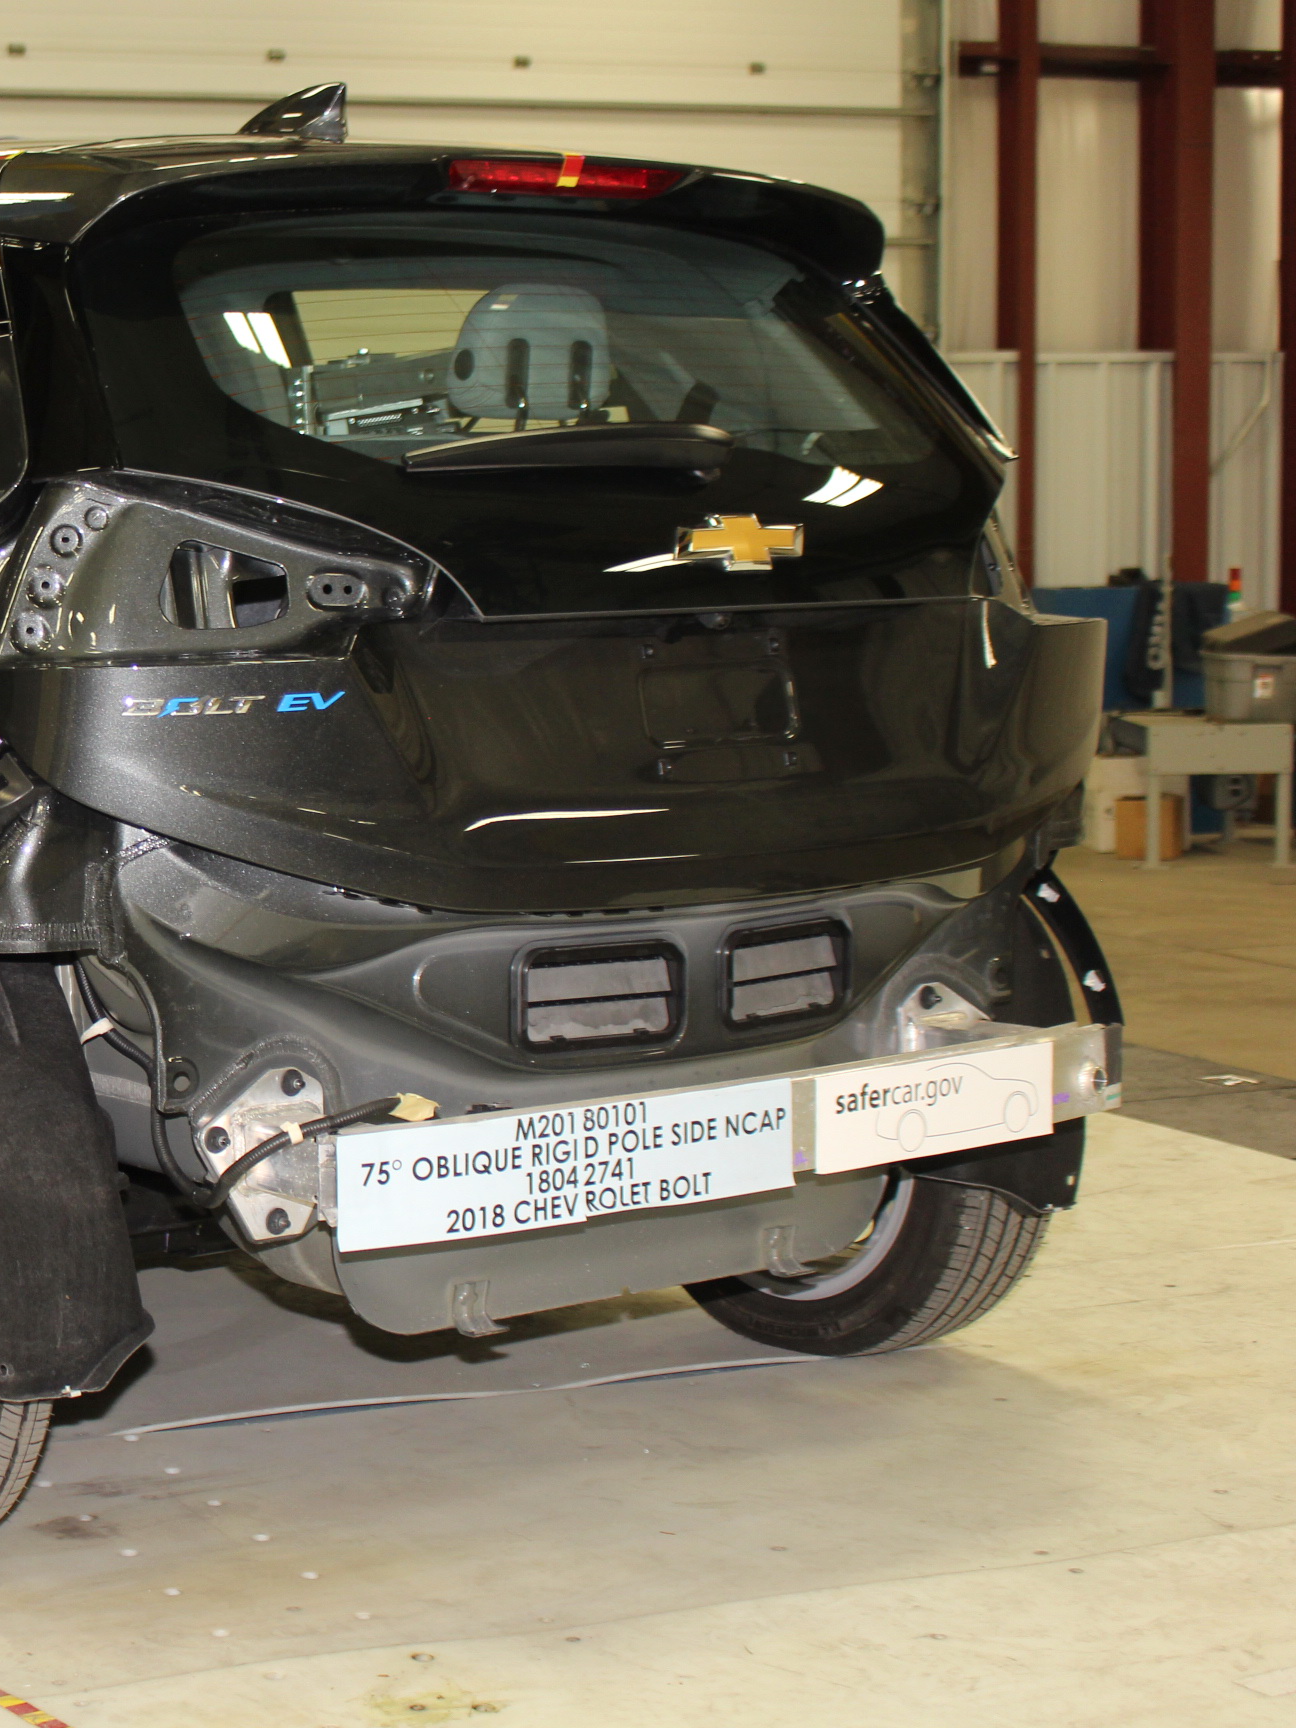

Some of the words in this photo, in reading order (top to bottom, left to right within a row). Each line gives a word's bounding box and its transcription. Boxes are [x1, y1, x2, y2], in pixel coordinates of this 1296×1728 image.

[122, 695, 266, 718] BOLT
[276, 690, 346, 712] EV
[835, 1075, 964, 1114] safercar.gov
[360, 1158, 403, 1187] 75°
[412, 1146, 523, 1182] OBLIQUE
[531, 1136, 598, 1167] RIGID
[607, 1125, 664, 1156] POLE
[670, 1117, 718, 1147] SIDE
[725, 1107, 787, 1138] NCAP
[446, 1203, 506, 1234] 2018
[513, 1181, 650, 1225] CHEVROLET
[659, 1172, 712, 1200] BOLT
